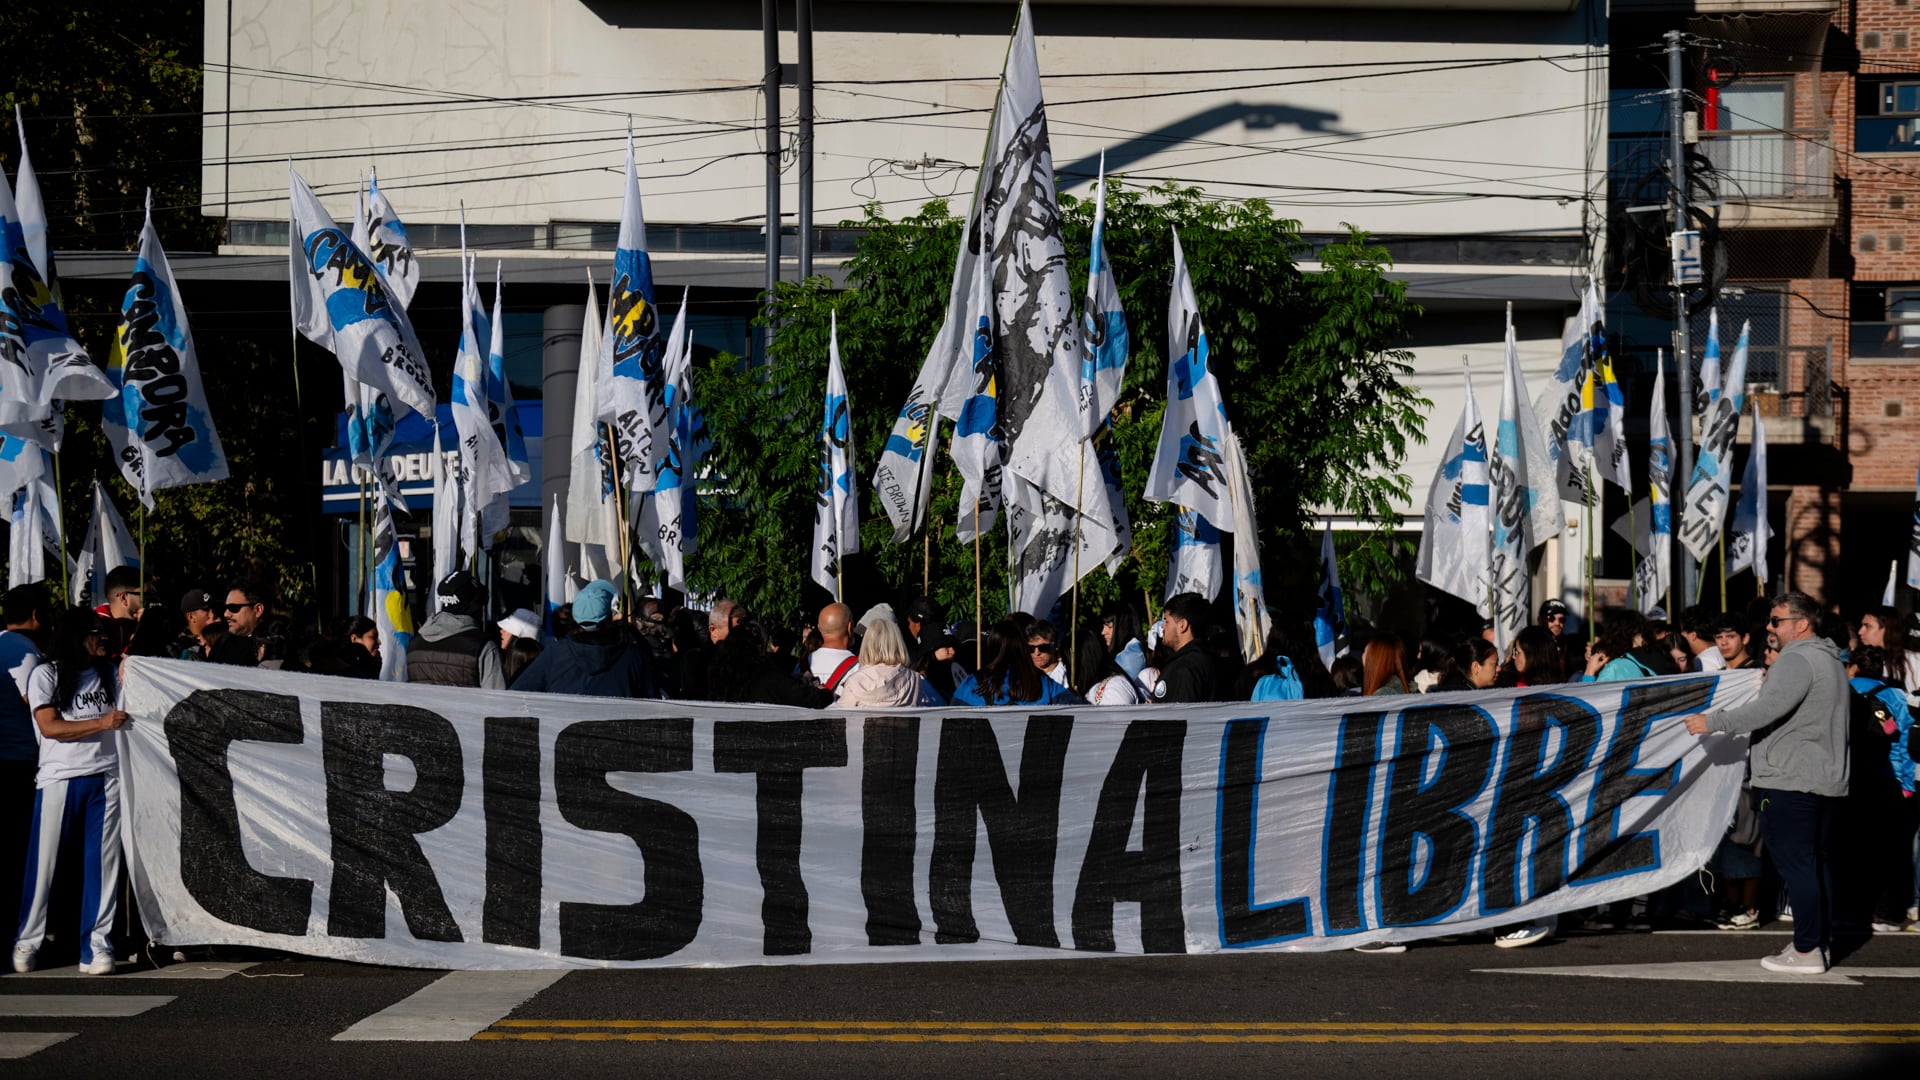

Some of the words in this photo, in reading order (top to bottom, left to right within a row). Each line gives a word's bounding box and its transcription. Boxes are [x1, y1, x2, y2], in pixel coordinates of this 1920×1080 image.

[381, 347, 436, 398] BROWN
[323, 459, 348, 486] LA
[885, 483, 910, 524] BROWN
[163, 687, 1188, 960] CRISTINA
[1215, 674, 1719, 949] LIBRE
